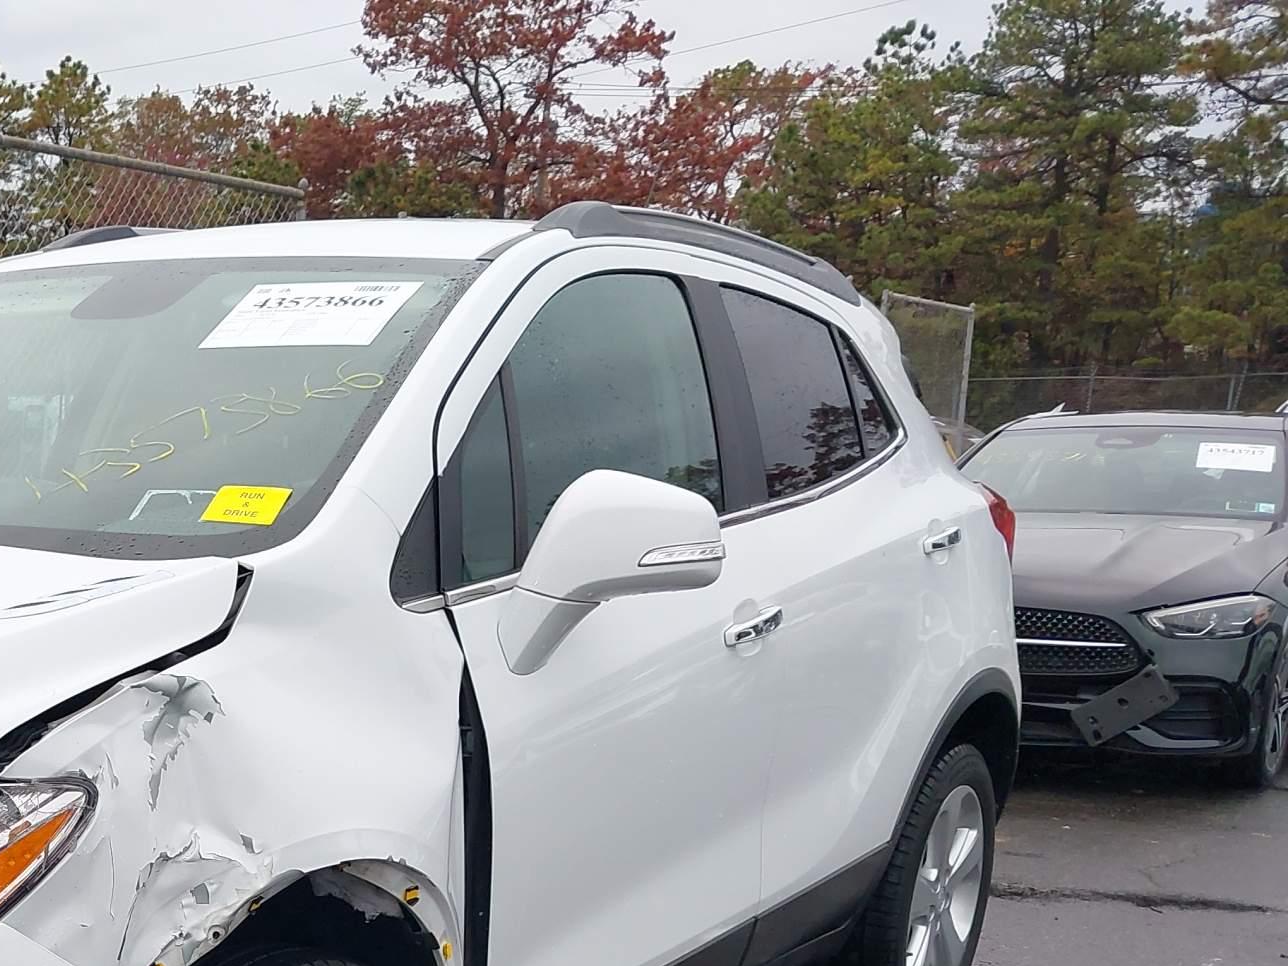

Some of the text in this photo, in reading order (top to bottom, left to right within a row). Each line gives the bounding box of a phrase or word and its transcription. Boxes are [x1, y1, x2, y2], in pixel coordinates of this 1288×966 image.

[253, 295, 386, 309] 43573866
[240, 492, 265, 500] RUN
[223, 509, 258, 518] DRIVE
